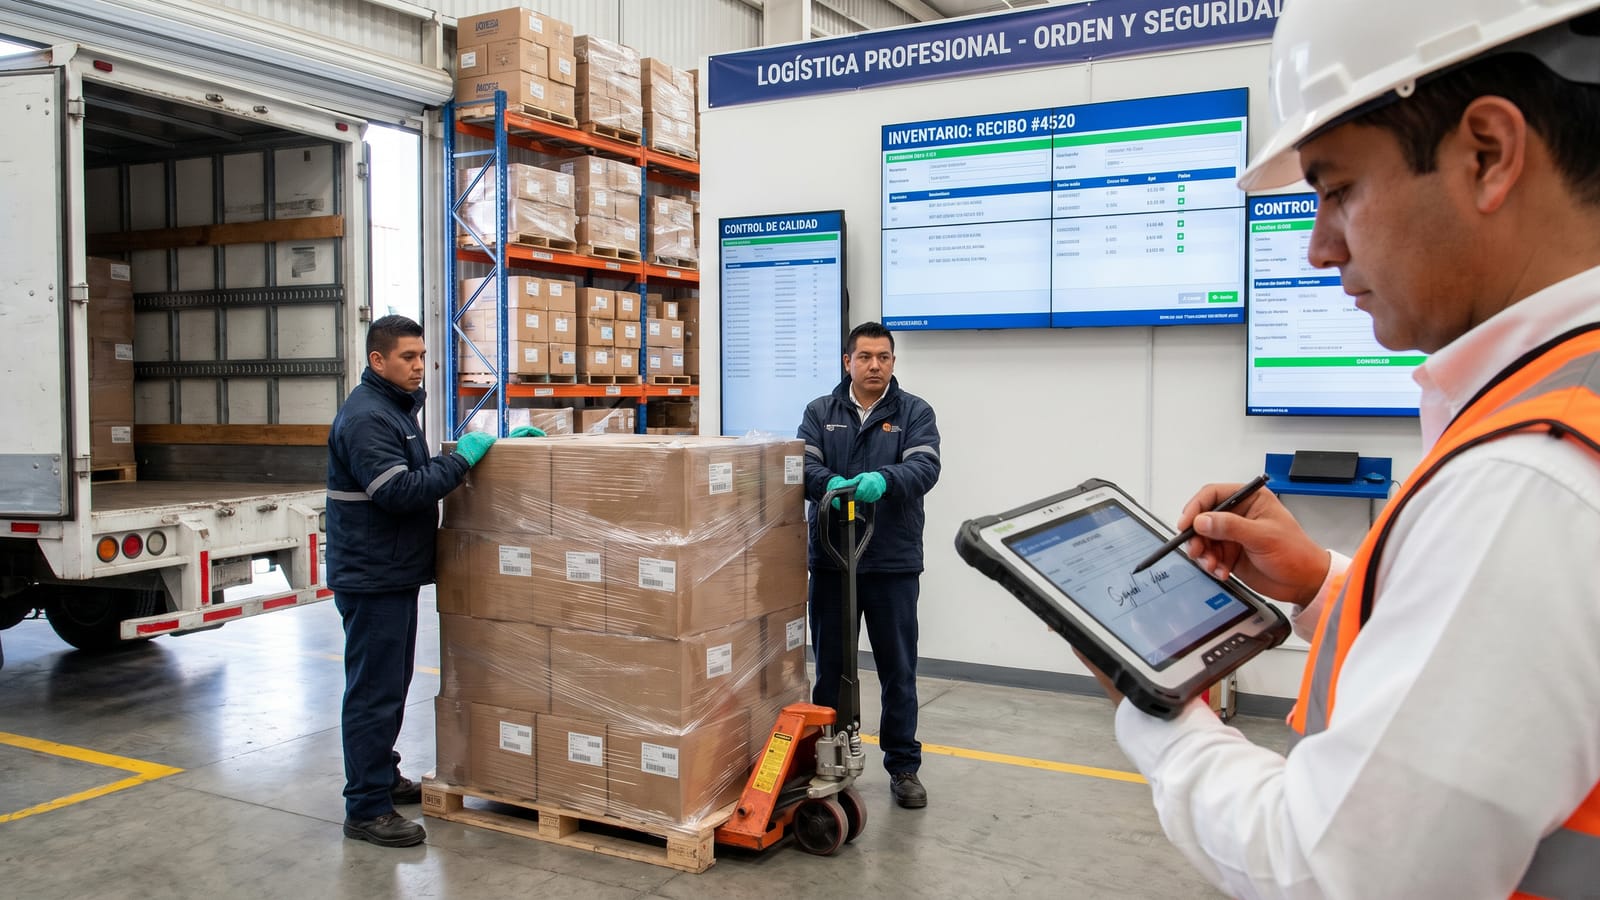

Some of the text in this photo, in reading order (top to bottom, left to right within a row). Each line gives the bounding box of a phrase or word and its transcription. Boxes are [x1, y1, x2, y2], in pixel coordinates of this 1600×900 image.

[757, 53, 859, 86] LOGÍSTICA
[865, 32, 1011, 73] PROFESIONAL
[1033, 16, 1113, 49] ORDEN
[1120, 13, 1137, 38] Y
[888, 113, 1076, 145] INVENTARIO: RECIBO #4520
[1254, 199, 1318, 216] CONTROL
[724, 219, 818, 234] CONTROL DE CALIDAD
